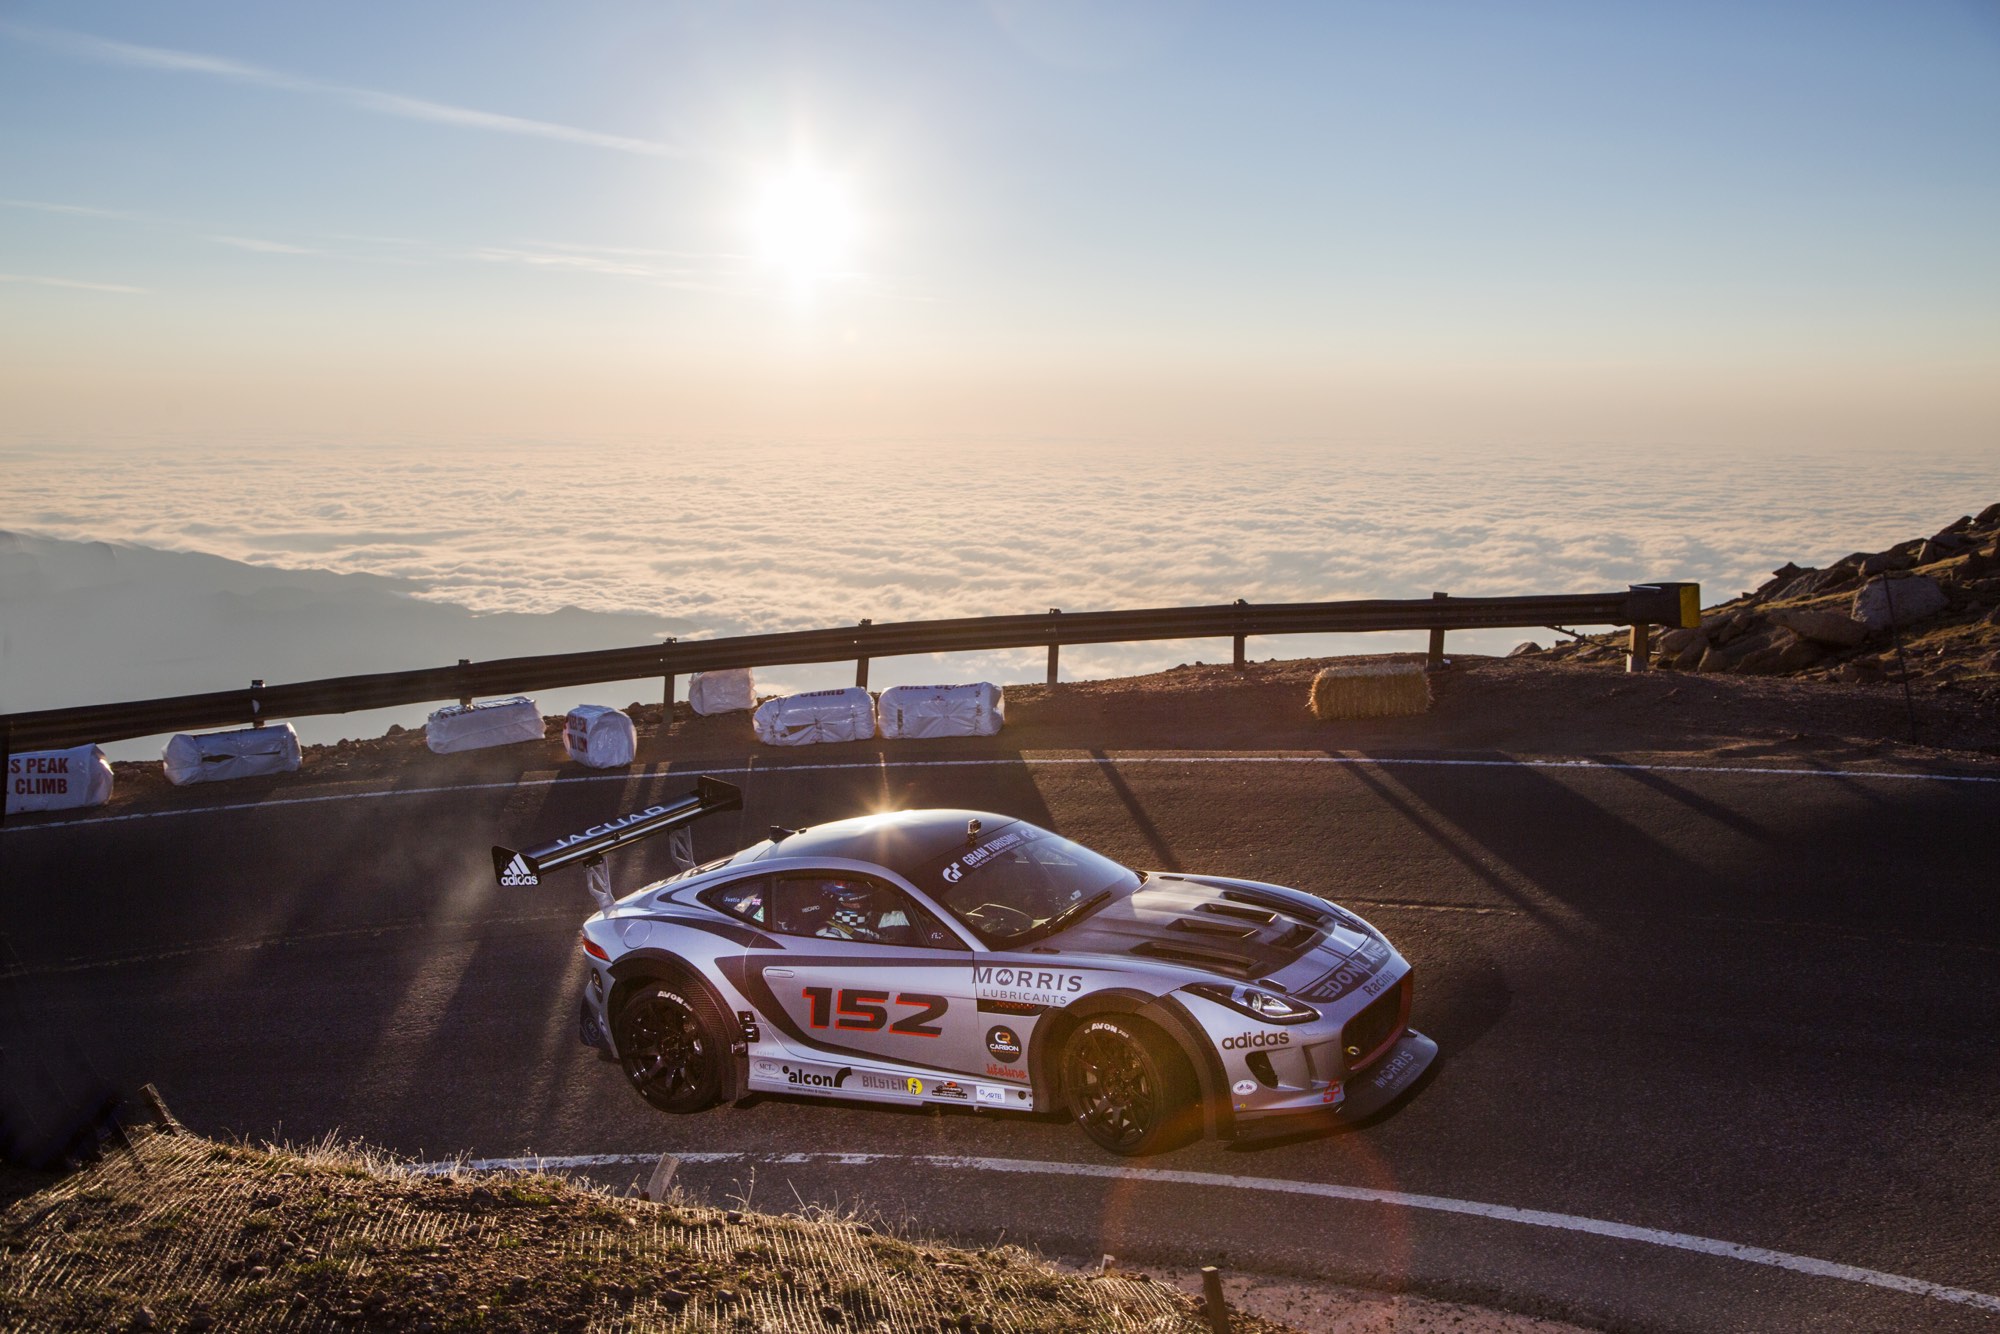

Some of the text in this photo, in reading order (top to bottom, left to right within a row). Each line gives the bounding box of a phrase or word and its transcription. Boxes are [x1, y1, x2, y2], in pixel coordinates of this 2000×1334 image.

[26, 757, 69, 773] PEAK
[15, 778, 68, 795] CLIMB
[556, 805, 666, 849] JAGUAR
[962, 846, 989, 866] GRAN
[984, 833, 1020, 852] TURISMO
[501, 873, 538, 886] adidas
[971, 967, 1083, 993] MORRIS
[1362, 970, 1398, 997] Racing
[657, 990, 684, 1004] AVON
[983, 989, 1067, 1005] LUBRICANTS
[802, 986, 948, 1038] 152
[1091, 1022, 1118, 1034] AVON
[989, 1043, 1019, 1052] CARBON
[1221, 1029, 1290, 1050] adidas
[788, 1068, 833, 1088] alcon
[1374, 1050, 1415, 1089] MORRIS
[862, 1075, 909, 1091] BILSTEIN
